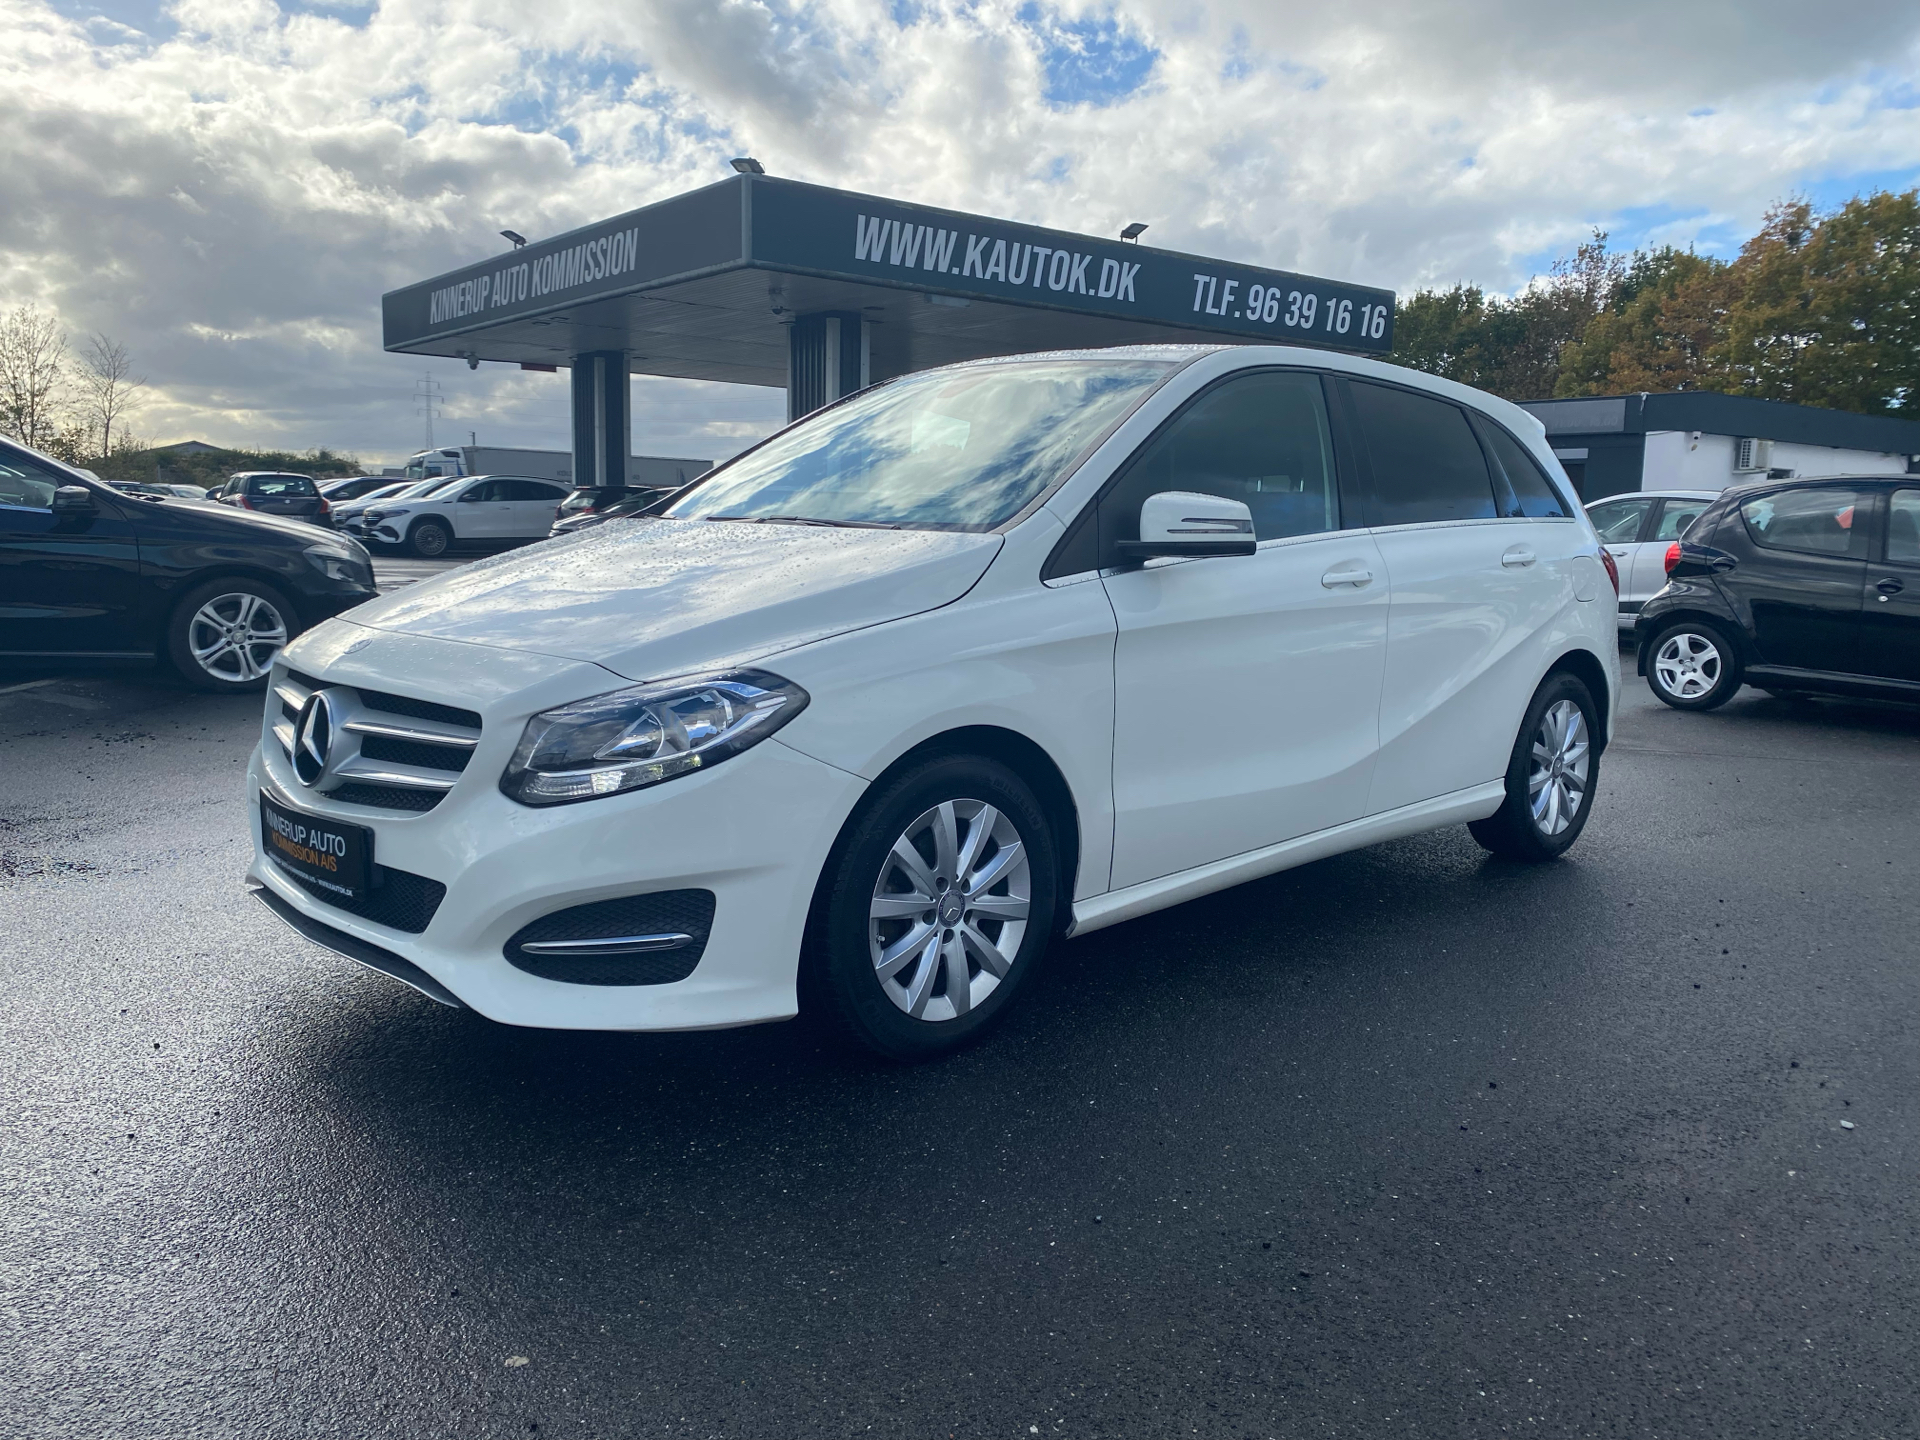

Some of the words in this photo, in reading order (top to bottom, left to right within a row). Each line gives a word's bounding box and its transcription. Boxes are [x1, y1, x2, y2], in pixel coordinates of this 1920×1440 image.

[430, 275, 490, 324] KINNERUP
[491, 263, 529, 308] AUTO
[531, 228, 639, 298] KOMMISSION
[855, 214, 1141, 302] WWW.KAUTOK.DK
[1193, 274, 1241, 318] TLF.
[1246, 284, 1281, 324] 96
[1285, 291, 1318, 329] 39
[1326, 298, 1353, 334] 16
[1361, 303, 1387, 339] 16
[310, 829, 346, 857] AUTO
[321, 853, 337, 872] A/S
